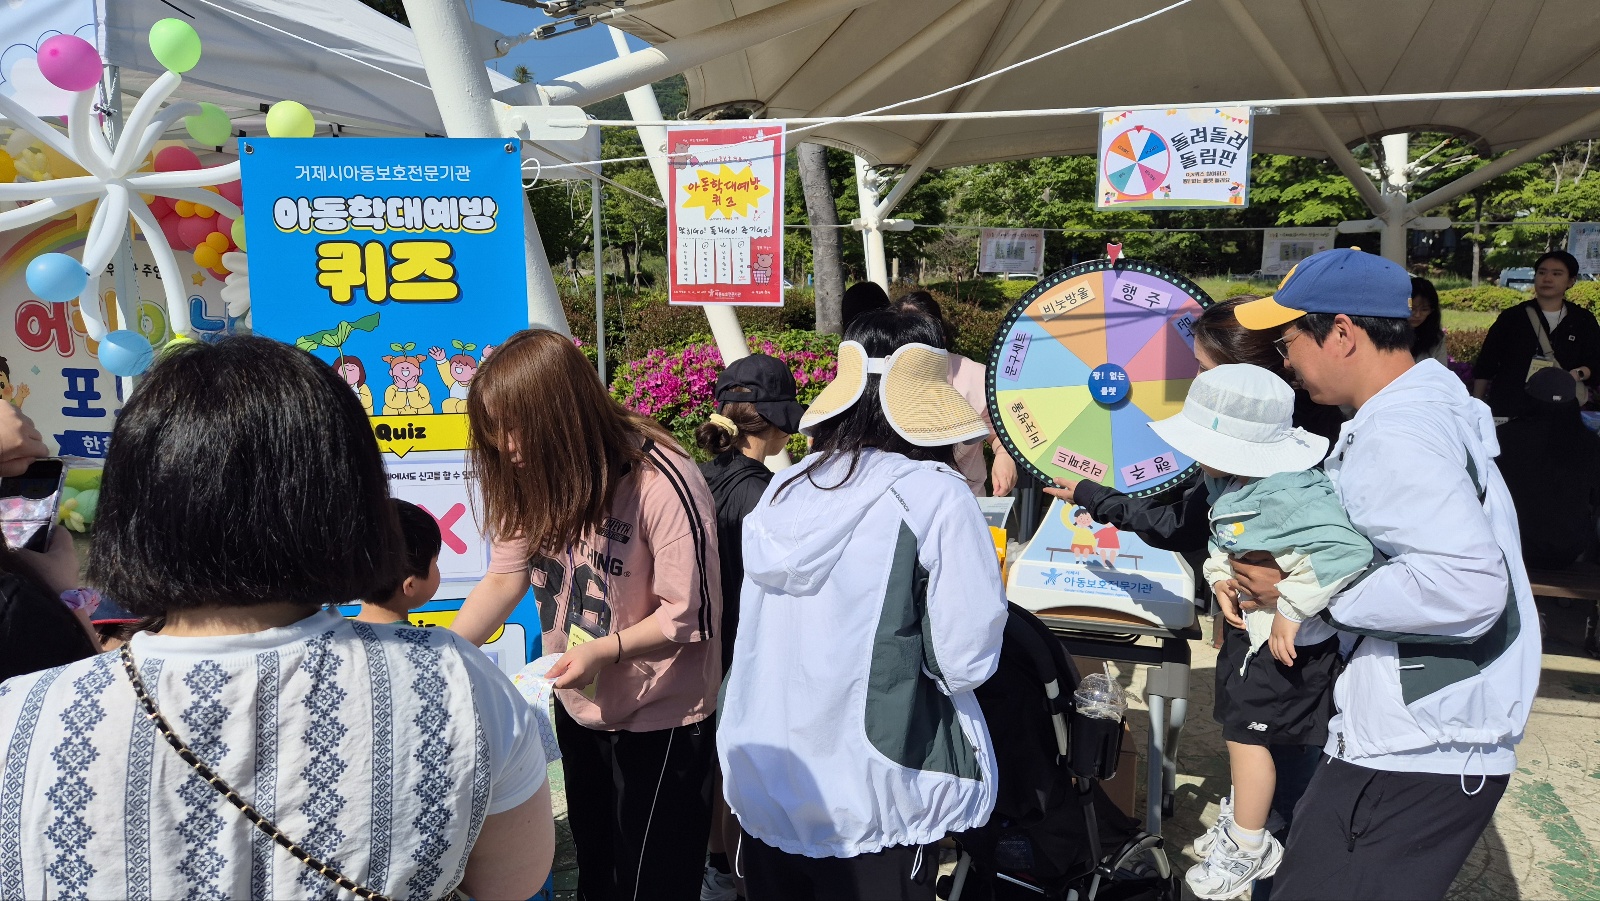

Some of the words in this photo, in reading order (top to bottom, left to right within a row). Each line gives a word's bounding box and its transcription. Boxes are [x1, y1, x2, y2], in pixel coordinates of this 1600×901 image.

[1170, 126, 1249, 152] 돌려돌려
[1179, 148, 1238, 170] 돌림판
[294, 164, 472, 182] 거제시아동보호전문기관
[687, 176, 761, 195] 아동학대예방
[273, 195, 498, 233] 아동학대예방
[316, 239, 461, 304] 퀴즈
[1042, 286, 1090, 314] 비눗방울
[1004, 331, 1027, 377] 문구세트
[1092, 371, 1104, 381] 꽝!
[1109, 371, 1126, 381] 없는
[1100, 386, 1117, 396] 룰렛
[375, 423, 427, 442] Quiz
[1011, 401, 1041, 445] 비눗방울
[1057, 450, 1103, 477] 리갈패드
[418, 471, 441, 481] 신고를
[442, 471, 452, 480] 할
[453, 471, 461, 480] 수
[1064, 576, 1153, 595] 아동보호전문기관
